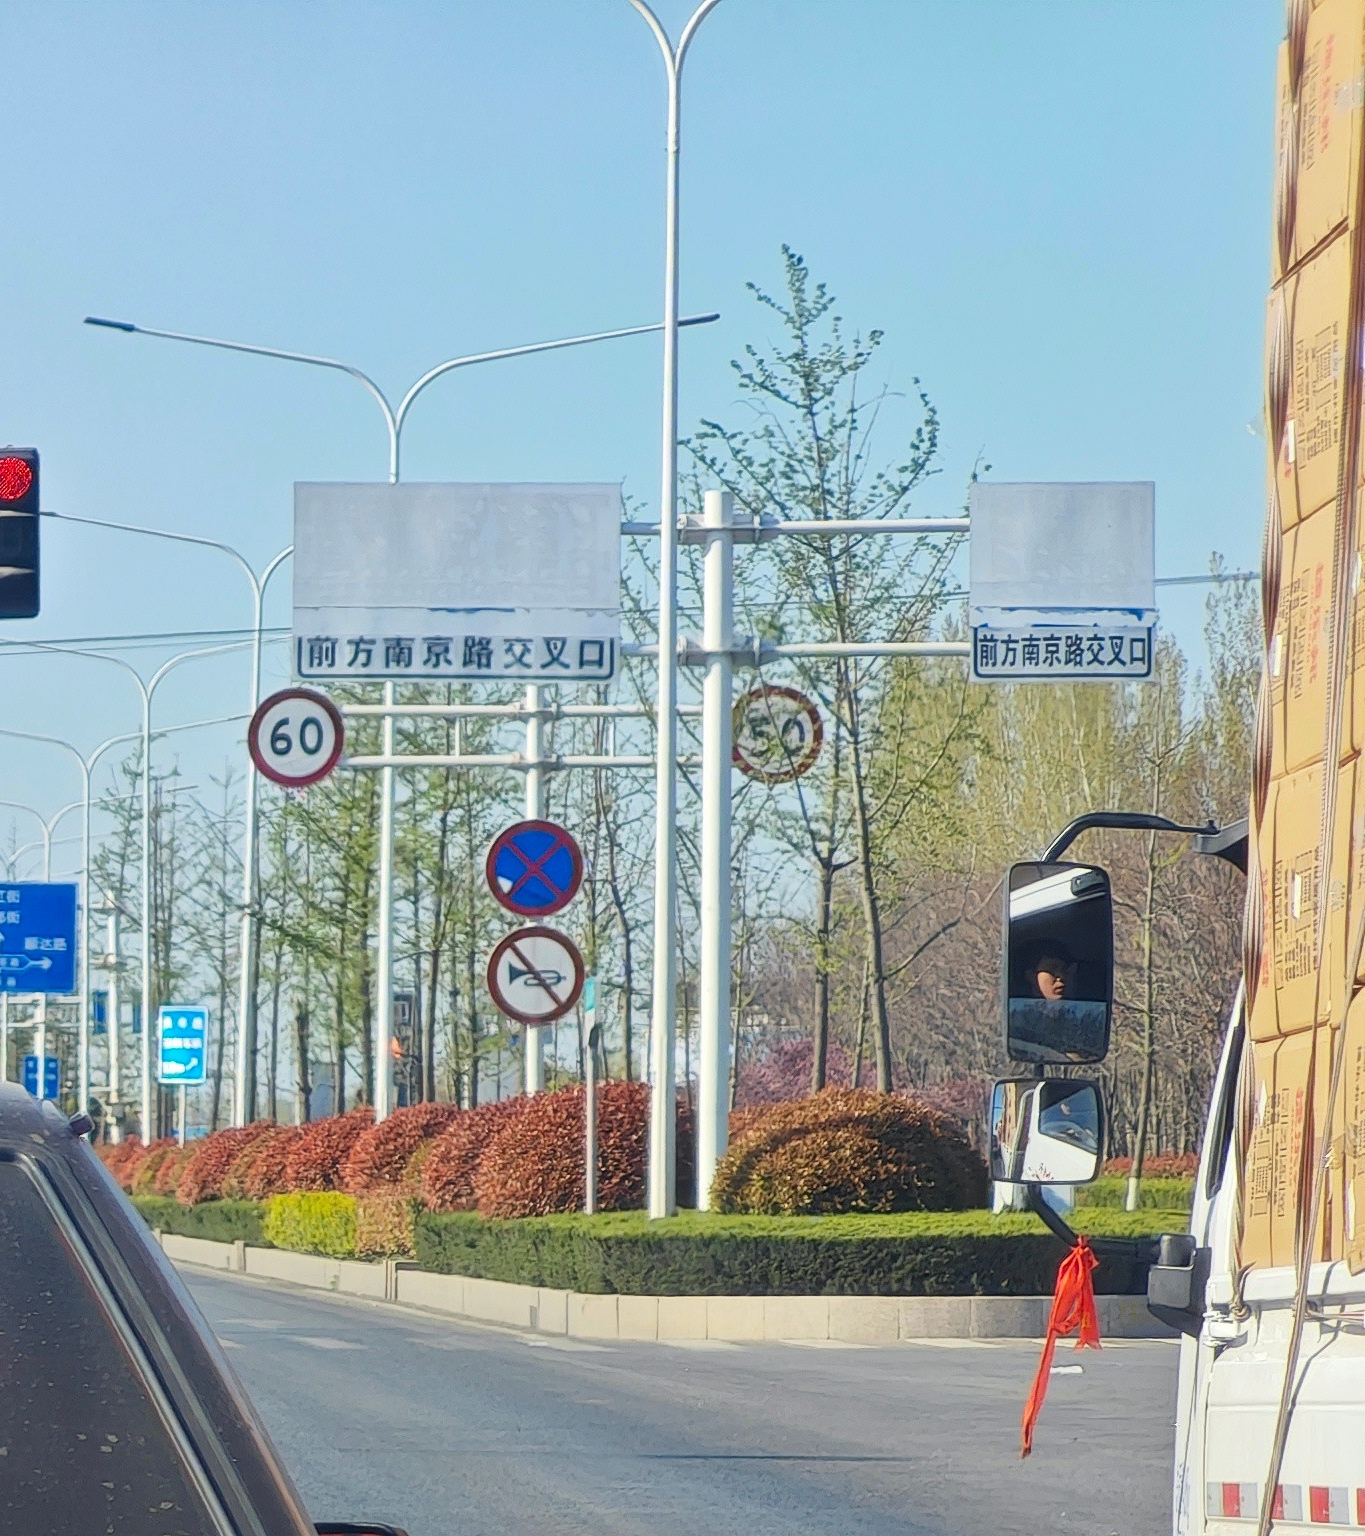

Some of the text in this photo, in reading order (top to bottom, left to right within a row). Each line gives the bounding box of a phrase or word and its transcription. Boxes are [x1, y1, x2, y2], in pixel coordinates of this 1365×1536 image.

[307, 635, 606, 670] 前方南京路交叉口
[978, 633, 1147, 668] 前方南京路交叉口
[270, 716, 325, 756] 60
